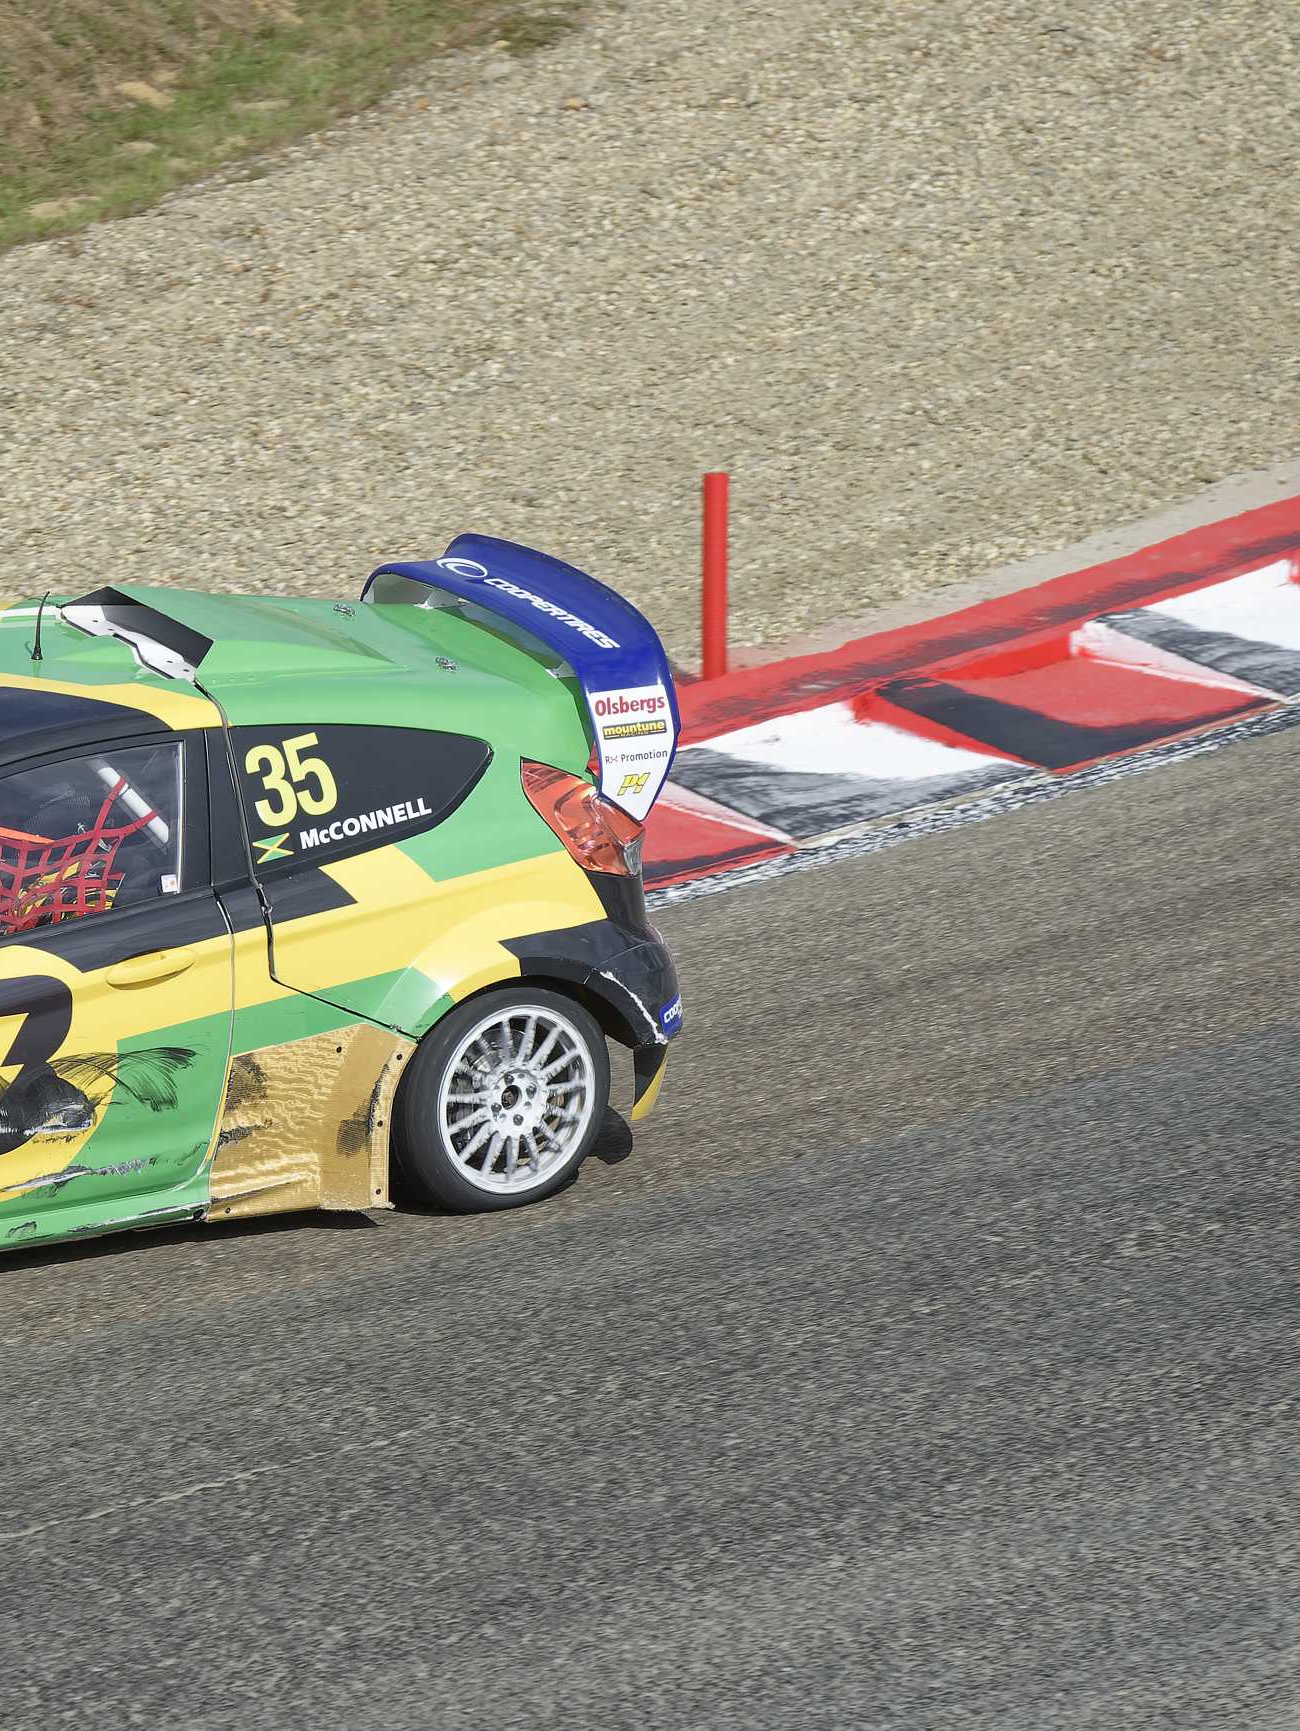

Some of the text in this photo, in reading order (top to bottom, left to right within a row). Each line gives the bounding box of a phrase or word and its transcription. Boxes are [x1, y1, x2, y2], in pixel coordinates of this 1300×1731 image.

[595, 696, 665, 716] Olsbergs
[604, 721, 665, 736] mountune
[621, 749, 668, 762] Promotion
[245, 732, 337, 826] 35
[300, 798, 432, 849] McCONNELL
